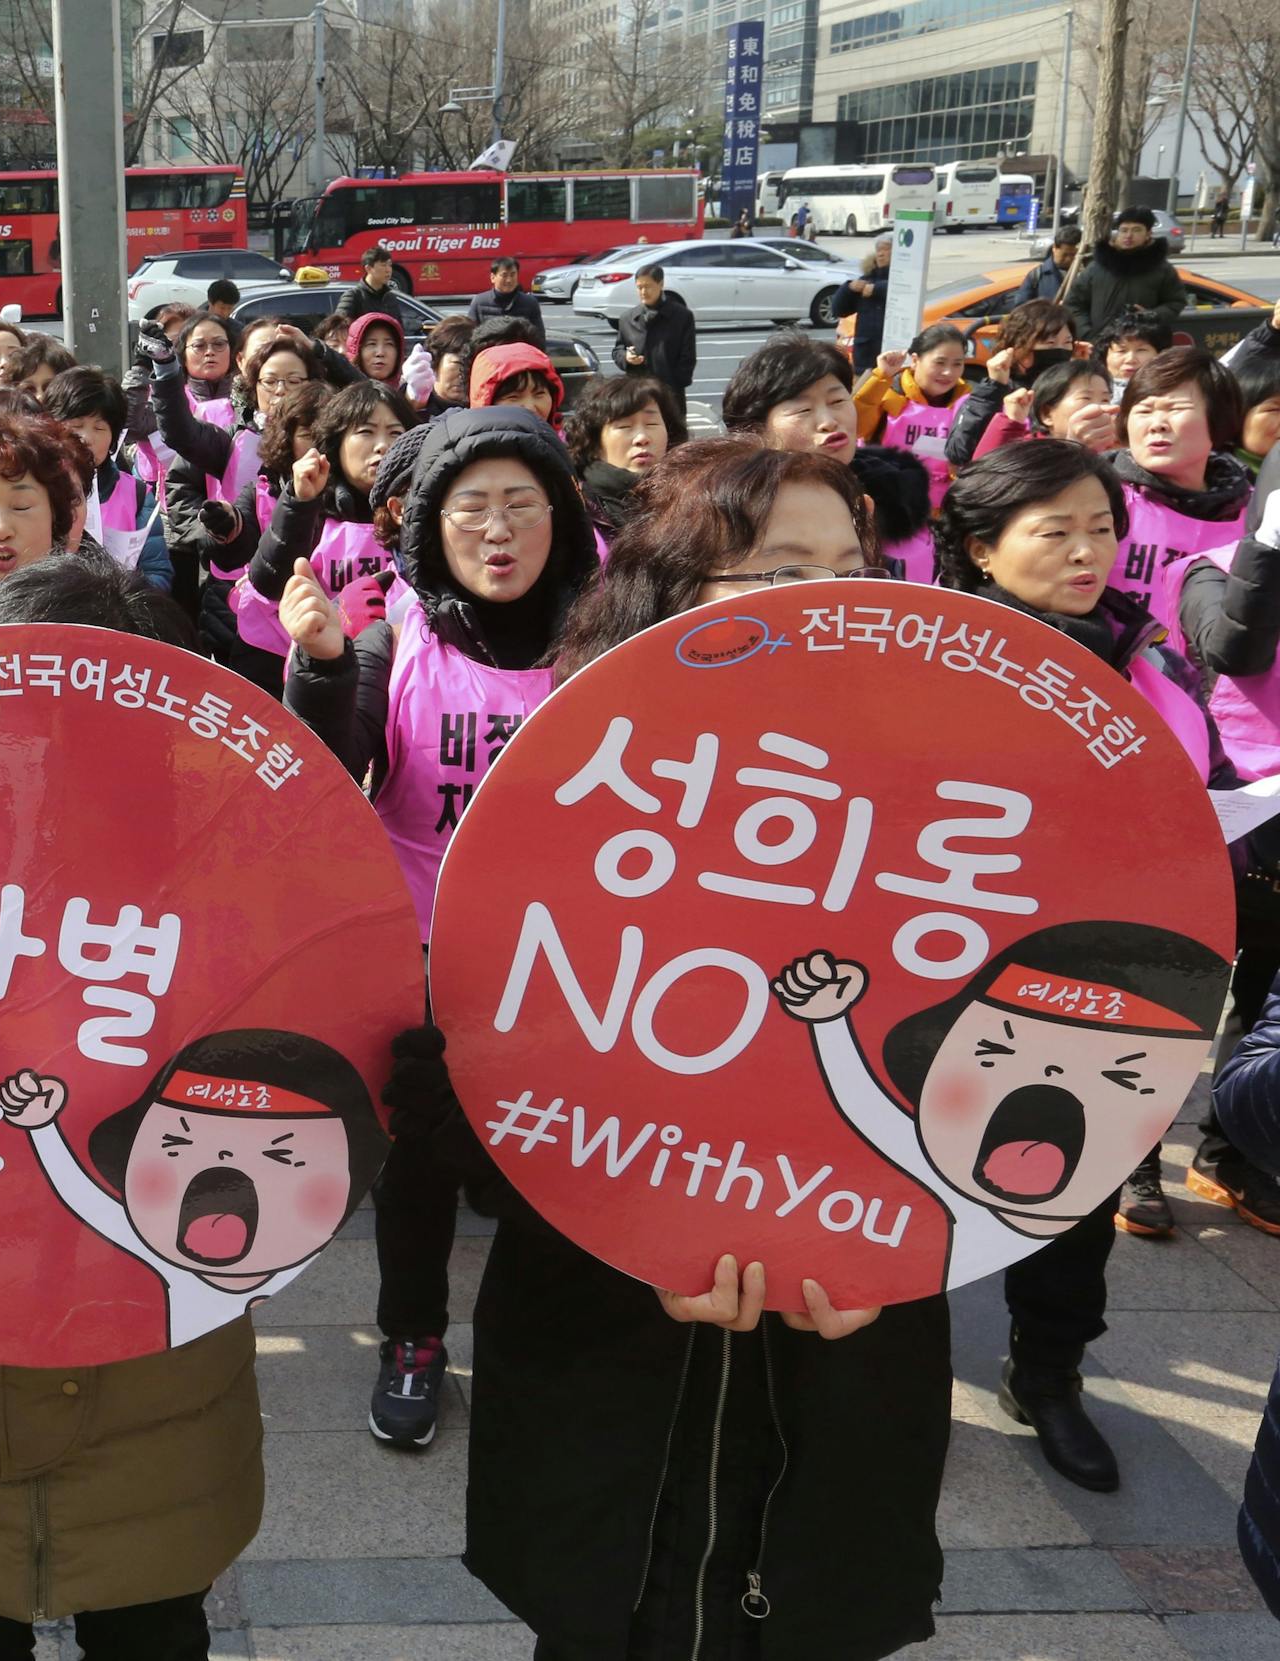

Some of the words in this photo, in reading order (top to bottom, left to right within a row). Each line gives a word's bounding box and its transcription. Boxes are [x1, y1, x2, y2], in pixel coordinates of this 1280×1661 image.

[377, 236, 421, 251] Seoul
[426, 236, 467, 253] Tiger
[470, 235, 501, 249] Bus
[799, 604, 1148, 770] 전국여성노동조합
[554, 716, 1039, 980] 성희롱
[493, 900, 771, 1075] NO
[1016, 981, 1129, 1020] 여성노조
[185, 1082, 272, 1110] 여성노조
[485, 1090, 914, 1248] #WithYou
